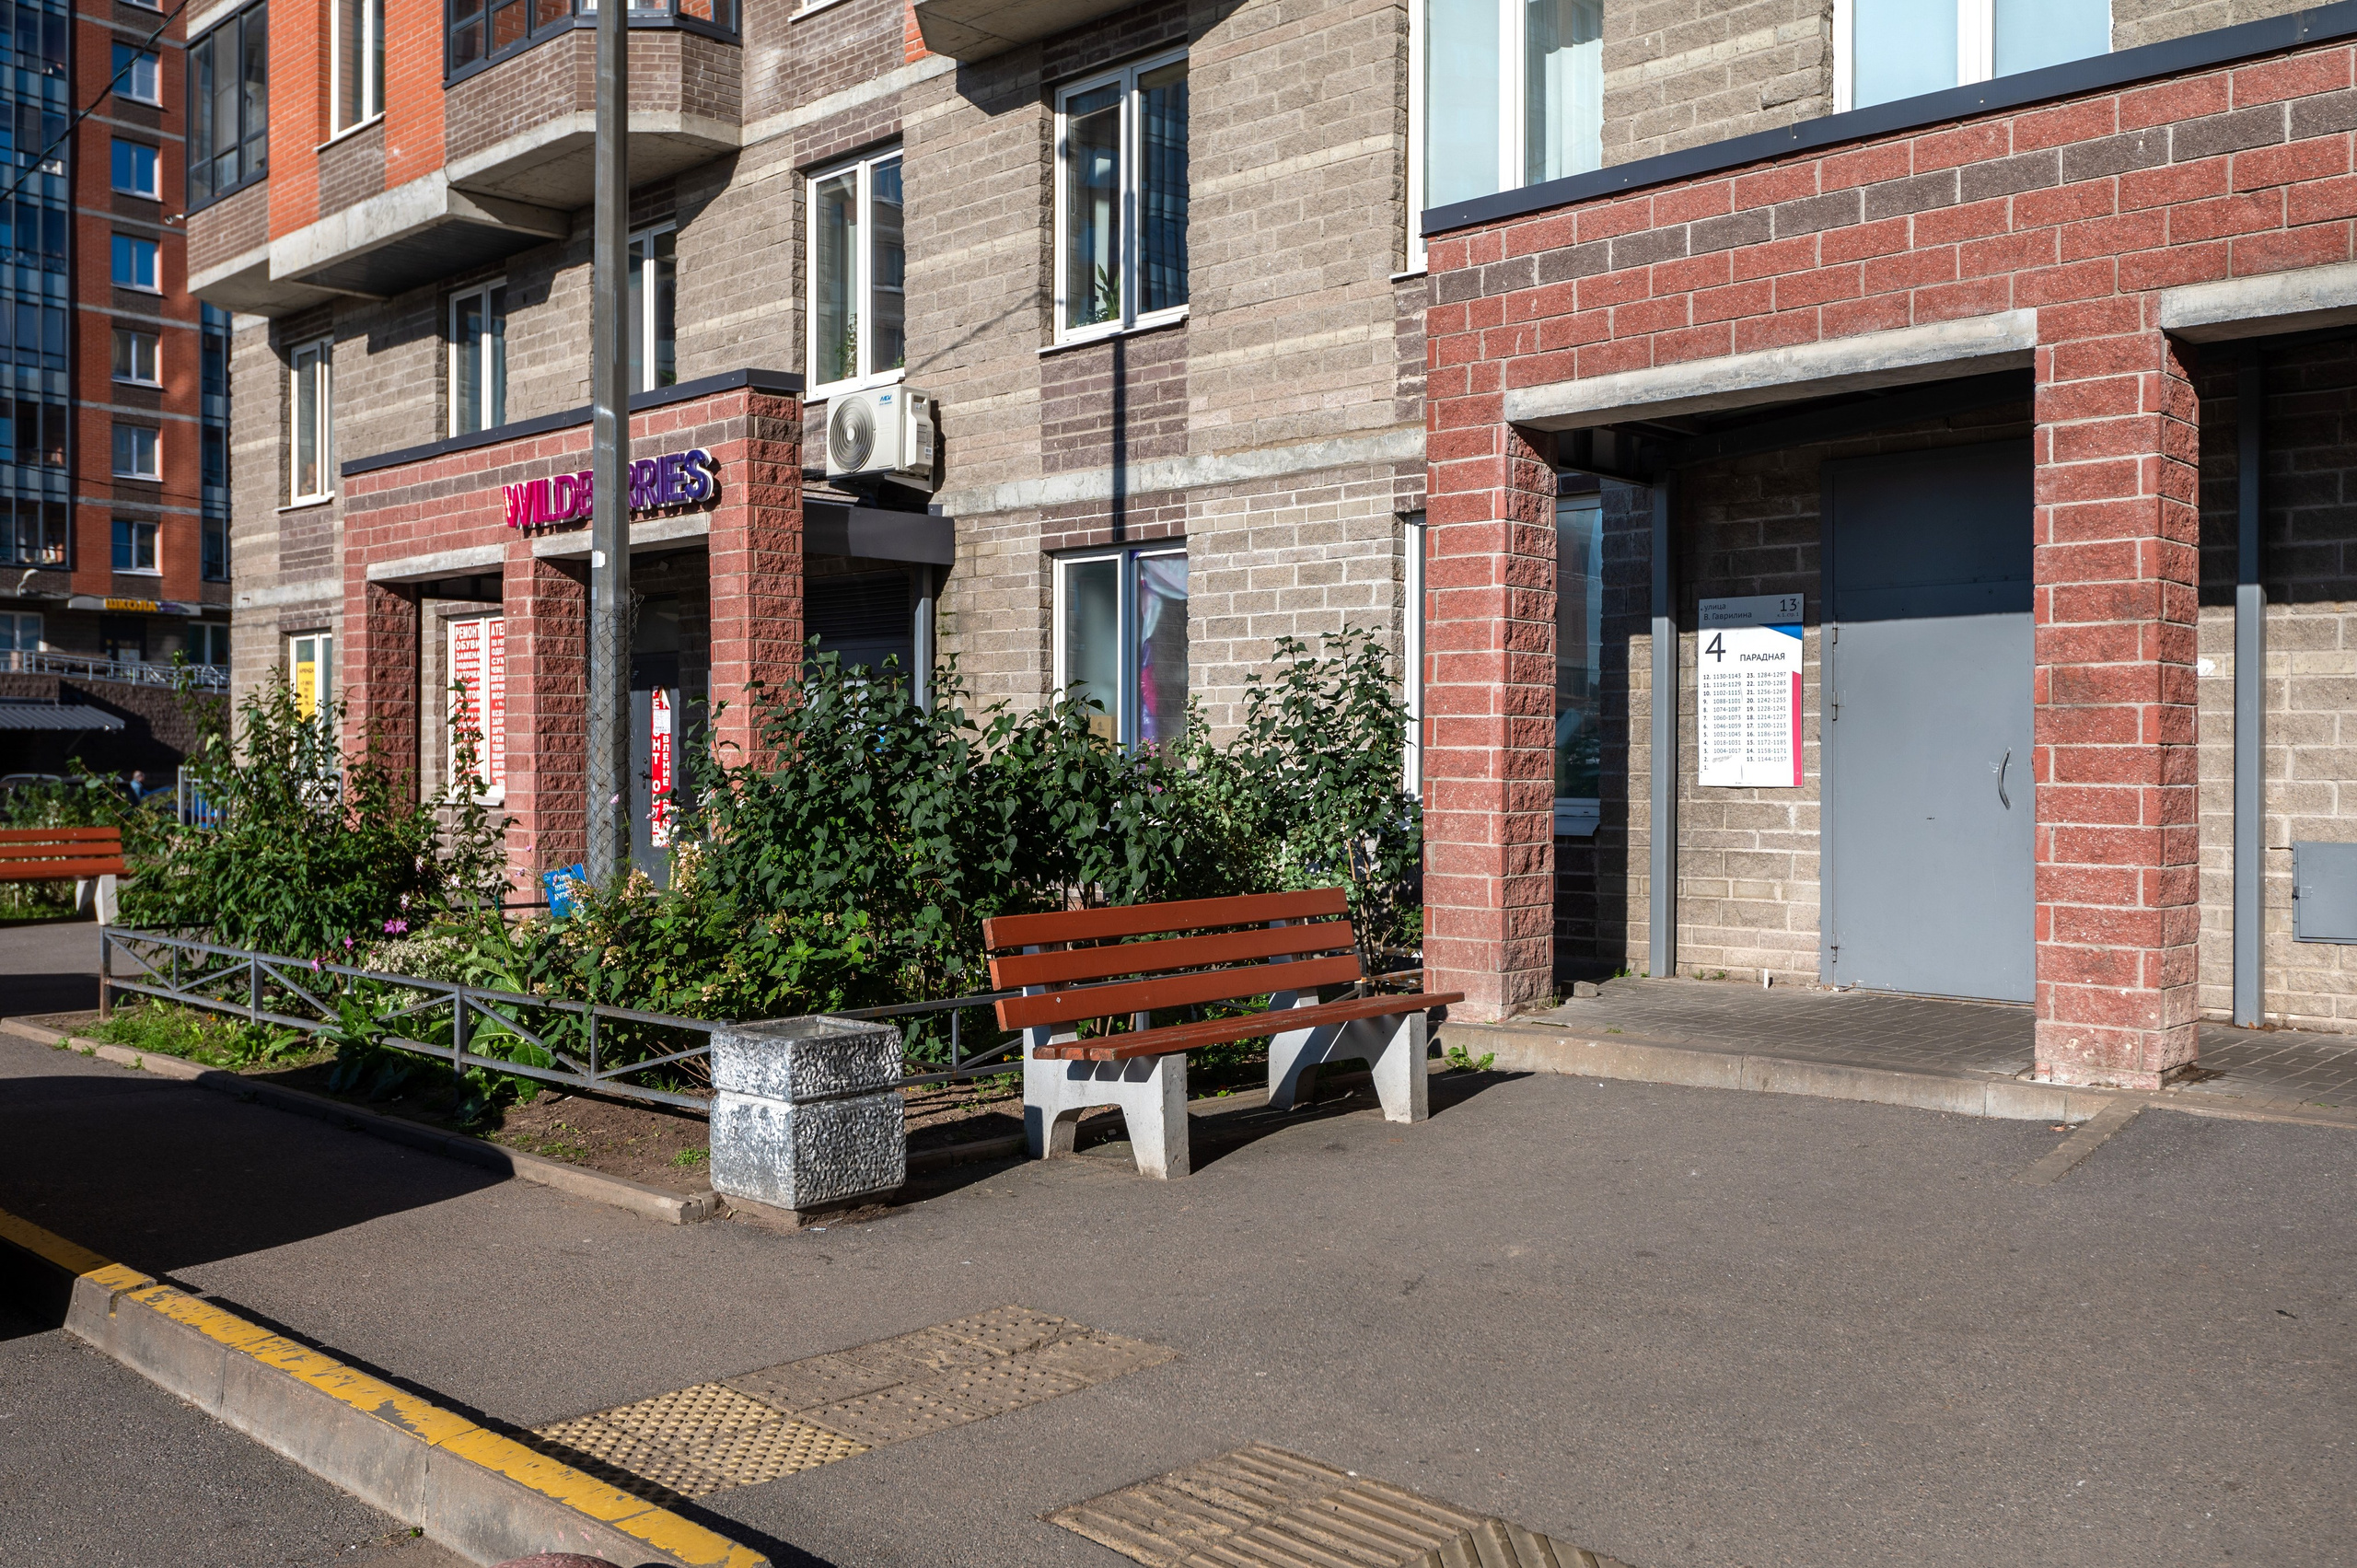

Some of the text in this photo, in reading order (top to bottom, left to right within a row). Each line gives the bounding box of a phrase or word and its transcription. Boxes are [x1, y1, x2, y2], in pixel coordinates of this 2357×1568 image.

[503, 448, 714, 529] WILDBRIES
[104, 598, 157, 611] ШКОЛА
[1704, 604, 1726, 612] улица
[1780, 598, 1797, 611] 13
[1712, 612, 1752, 621] Гаврилина
[455, 625, 480, 639] РЕМОНТ
[1705, 632, 1726, 663] 4
[1739, 652, 1786, 662] ПАРАДНАЯ
